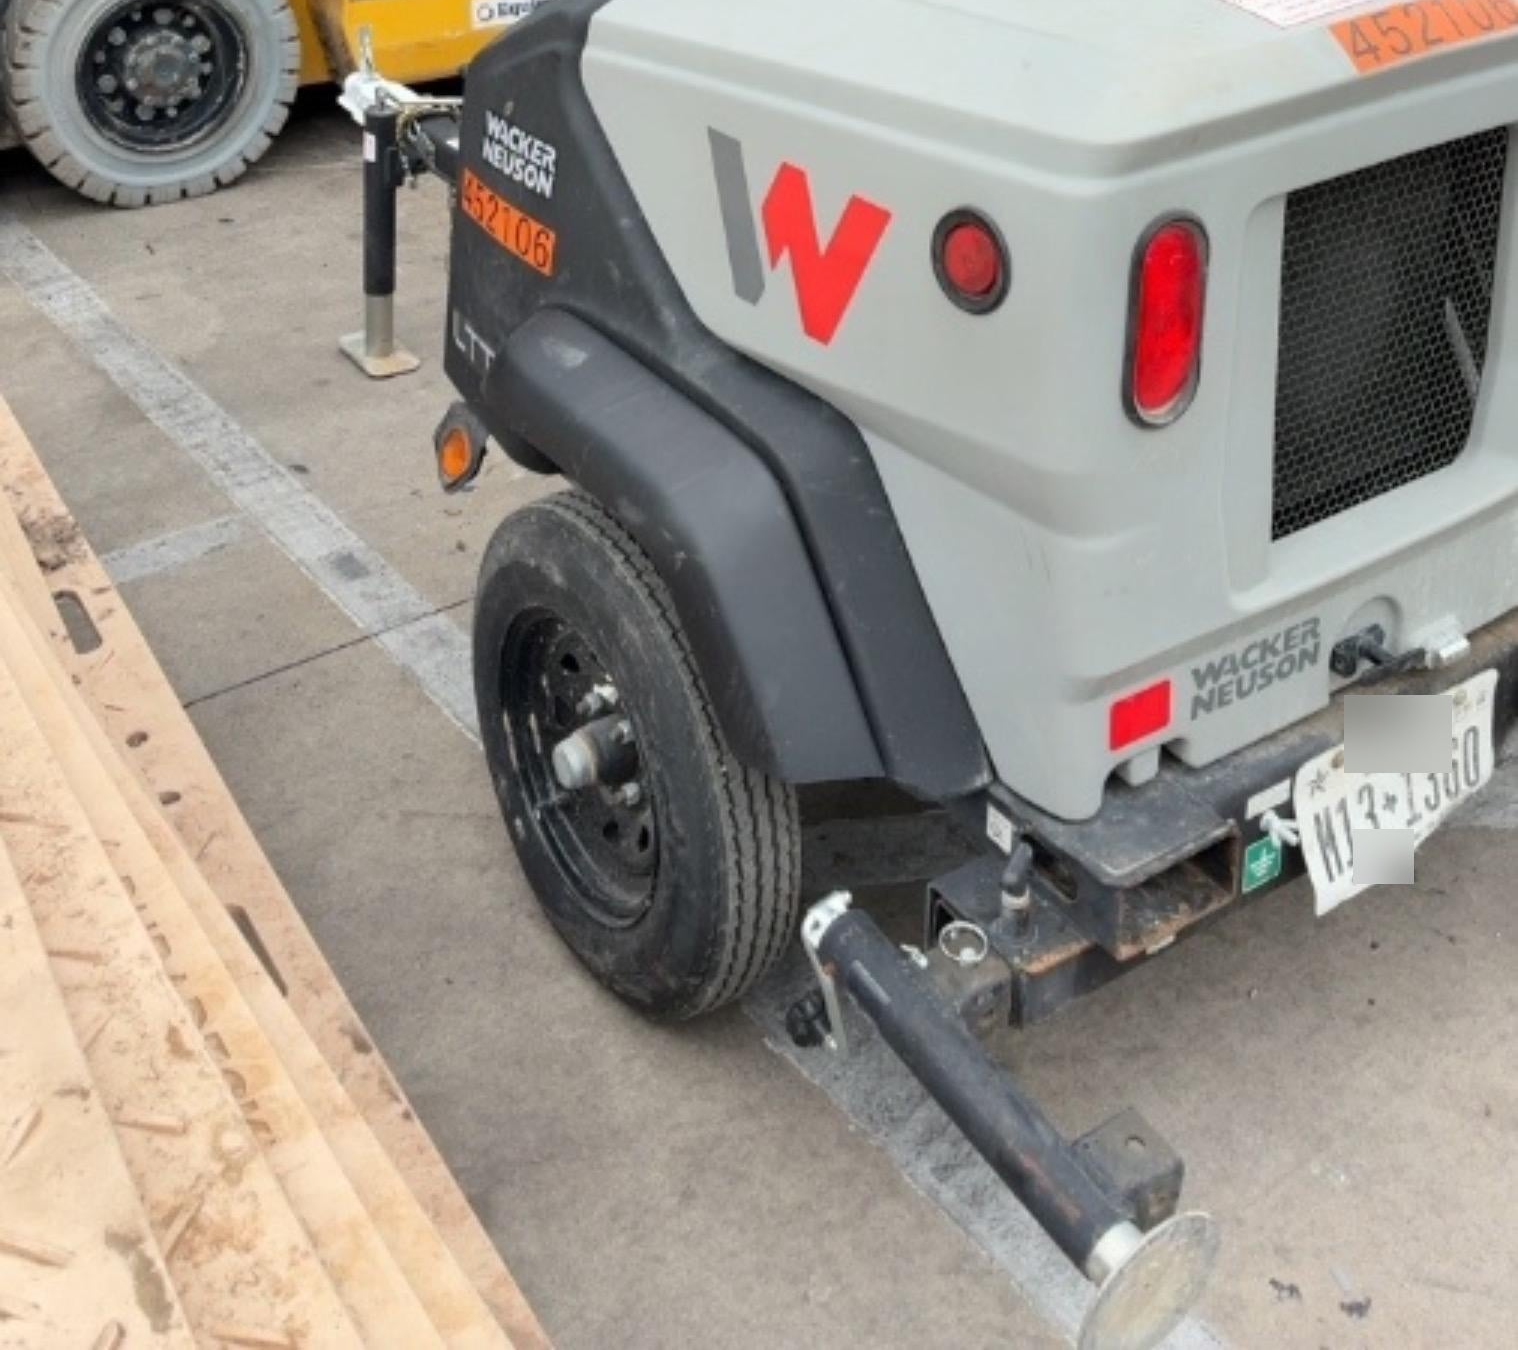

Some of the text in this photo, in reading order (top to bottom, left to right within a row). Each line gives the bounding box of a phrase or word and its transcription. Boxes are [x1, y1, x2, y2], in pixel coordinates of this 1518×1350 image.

[482, 137, 554, 199] NEUSON
[485, 109, 557, 172] WACKER
[463, 174, 551, 270] 452106
[1190, 641, 1321, 722] NEUSON
[1191, 617, 1321, 692] WACKER
